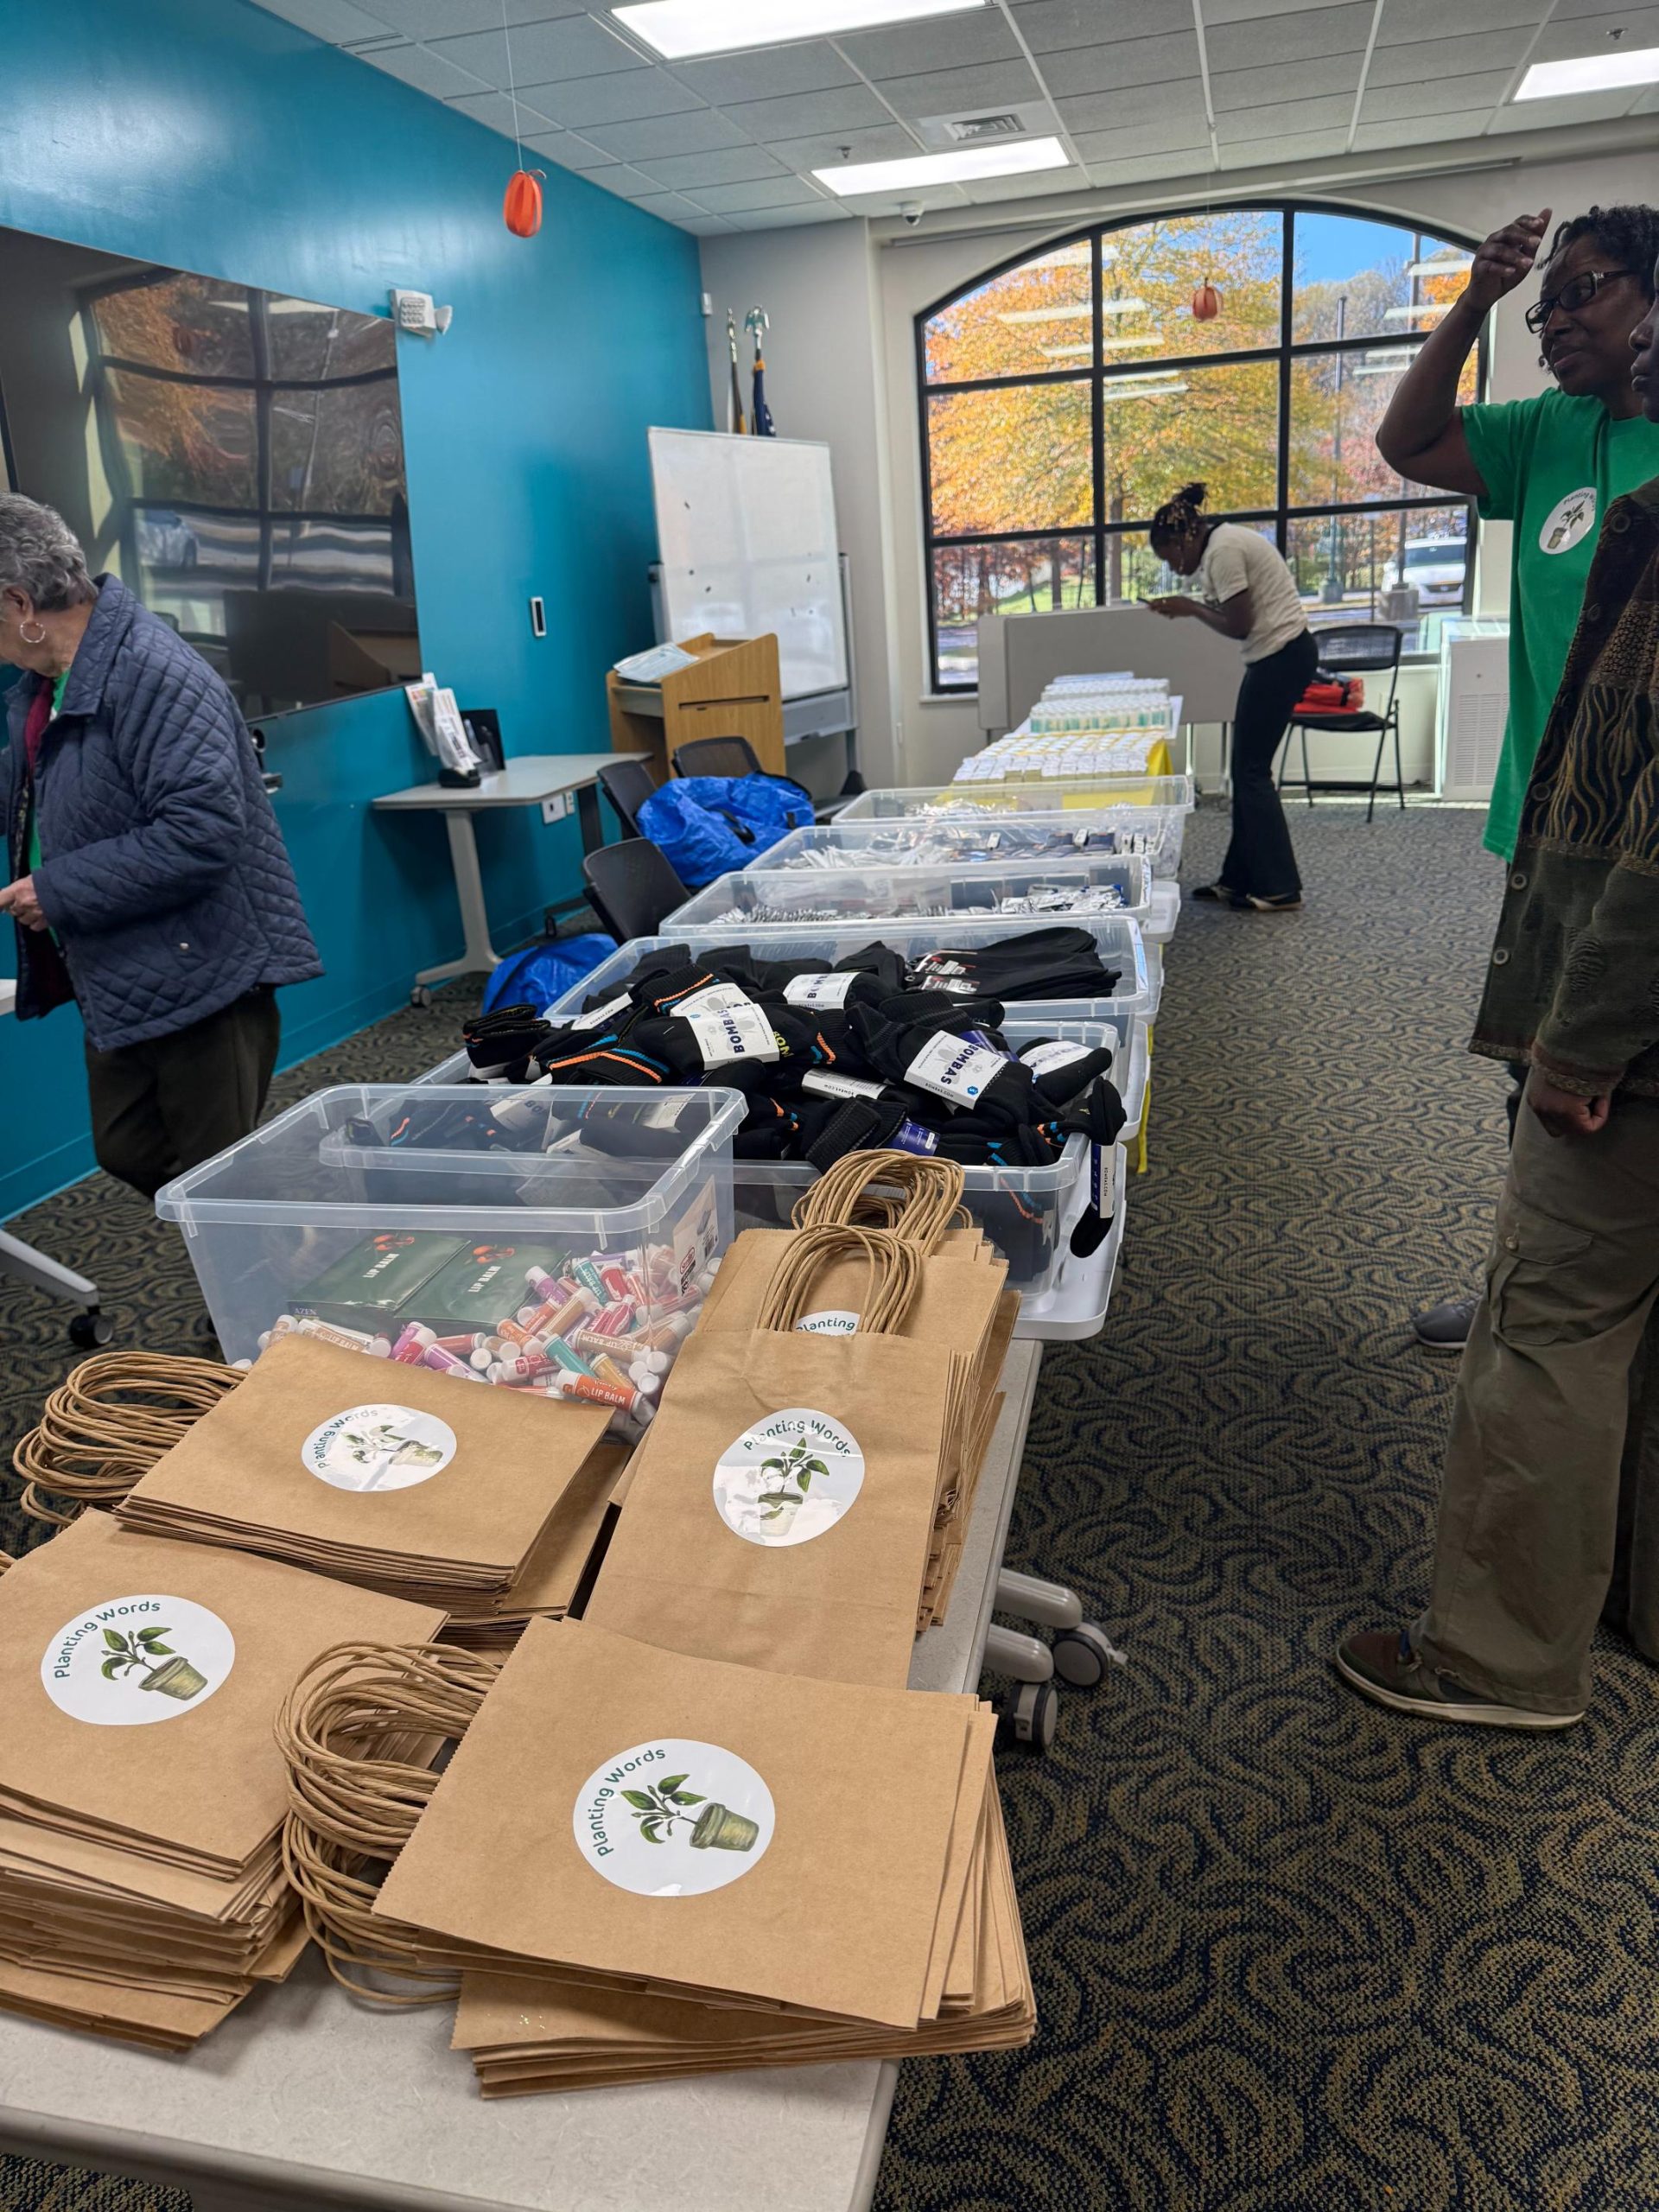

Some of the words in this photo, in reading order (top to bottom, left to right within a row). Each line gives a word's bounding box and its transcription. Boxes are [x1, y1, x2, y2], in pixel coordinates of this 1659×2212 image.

[717, 1009, 745, 1053] BOMBAS
[941, 1045, 979, 1084] BOMBAS
[362, 1268, 380, 1278] LIP
[374, 1253, 400, 1268] BALM
[467, 1282, 485, 1293] LIP
[477, 1265, 501, 1282] BALM
[590, 1387, 604, 1397] LIP
[604, 1391, 626, 1405] BALM
[313, 1430, 335, 1469] Planting
[329, 1409, 378, 1428] Words
[743, 1419, 805, 1451] Planting
[810, 1419, 850, 1458] Words
[54, 1622, 99, 1679] Planting
[95, 1601, 161, 1622] Words
[588, 1787, 614, 1857] Planting
[604, 1749, 666, 1784] Words
